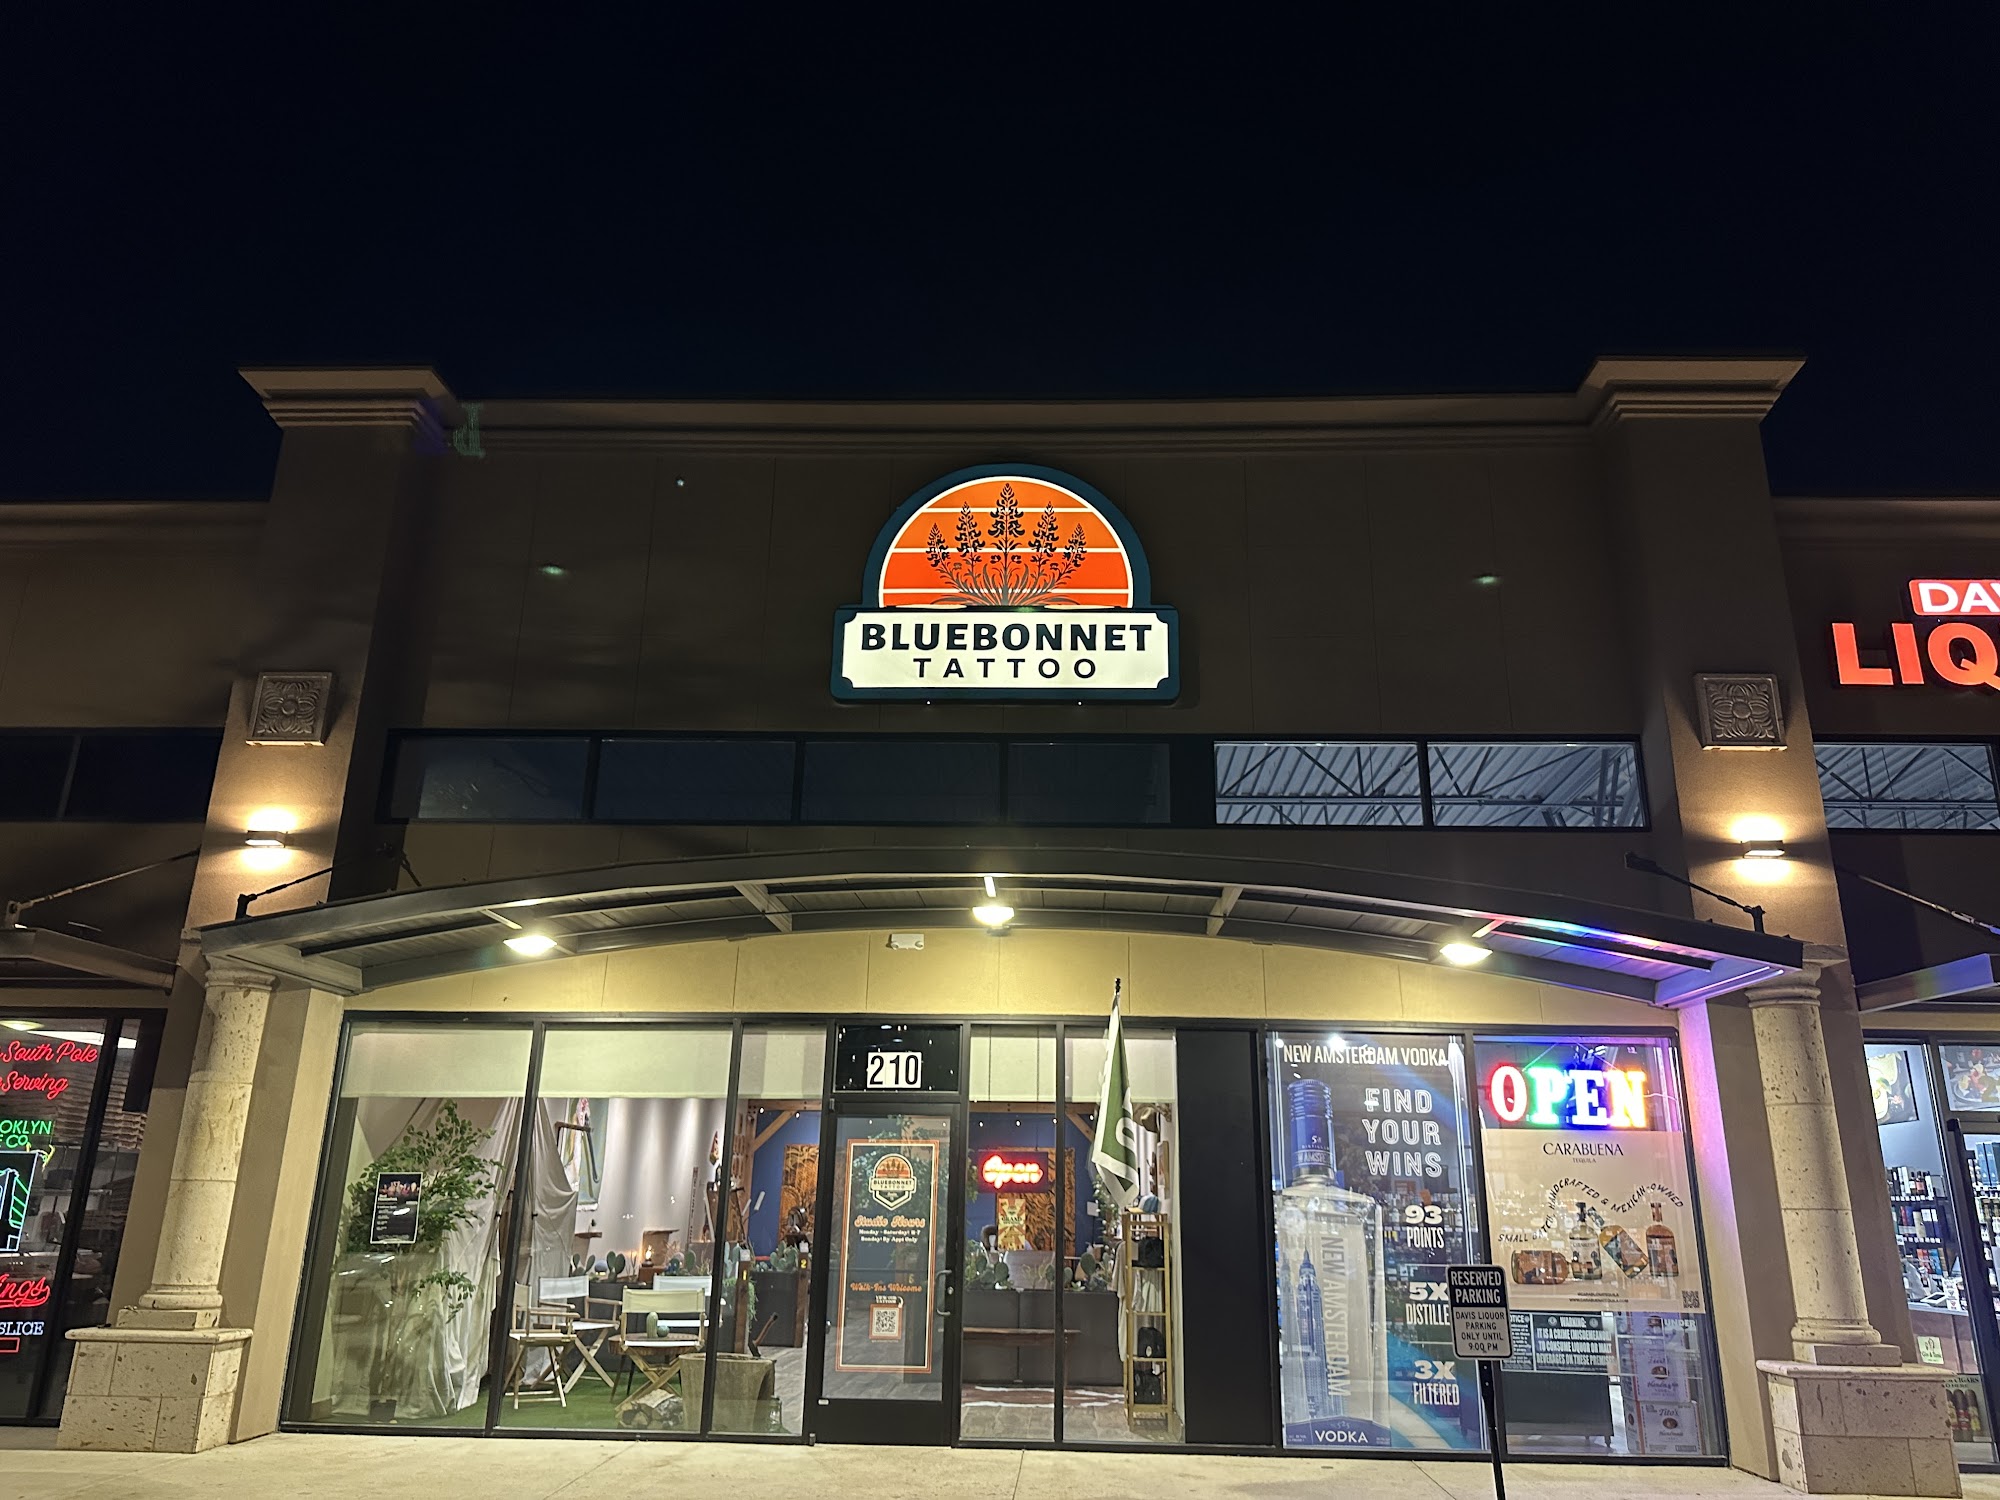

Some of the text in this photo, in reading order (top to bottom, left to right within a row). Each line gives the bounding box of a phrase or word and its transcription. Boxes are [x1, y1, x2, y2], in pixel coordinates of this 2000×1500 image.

[1918, 582, 2000, 613] DA
[861, 623, 1152, 652] BLUEBONNET
[1832, 622, 2000, 691] LIQ
[913, 658, 1096, 679] TATTOO
[3, 1040, 55, 1062] South
[56, 1041, 98, 1063] Pole
[1283, 1045, 1447, 1067] NEW AMSTERDAM VODKA
[869, 1054, 919, 1085] 210
[1, 1071, 68, 1100] Serving
[1365, 1087, 1433, 1114] FIND
[1491, 1065, 1647, 1128] OPEN
[1362, 1118, 1442, 1146] YOUR
[1543, 1142, 1624, 1156] CARABUENA
[983, 1155, 1043, 1189] Open
[1365, 1151, 1443, 1178] WINS
[1404, 1204, 1443, 1225] 93
[1498, 1233, 1529, 1243] SMALL
[1549, 1177, 1600, 1210] HANDCRAFTED
[1601, 1198, 1609, 1206] &
[1611, 1183, 1684, 1213] MEXICAN-OWNED
[854, 1214, 926, 1228] Studio Hours
[1406, 1226, 1445, 1248] POINTS
[801, 1258, 808, 1269] 2
[1321, 1236, 1346, 1277] NEW
[850, 1282, 923, 1292] Walk-Ins Welcome
[1450, 1270, 1502, 1287] RESERVED
[1409, 1282, 1449, 1301] 5X
[1455, 1288, 1501, 1304] PARKING
[1405, 1303, 1450, 1326] DISTILLE
[1455, 1311, 1505, 1320] DAVIS LIQUOR
[1559, 1316, 1587, 1328] WARNING:
[1664, 1319, 1696, 1327] UNDER
[0, 1321, 44, 1336] SLICE
[1465, 1321, 1497, 1330] PARKING
[1536, 1328, 1543, 1338] IT
[1544, 1328, 1549, 1339] IS
[1549, 1328, 1553, 1339] A
[1553, 1329, 1570, 1340] CRIME
[1323, 1278, 1351, 1396] AMSTERDAM
[1461, 1332, 1504, 1341] ONLY UNTIL
[1487, 1343, 1498, 1351] PM
[1547, 1341, 1572, 1352] CONSUME
[1414, 1360, 1456, 1380] 3X
[1573, 1355, 1589, 1365] THESE
[1413, 1382, 1460, 1406] FILTERED
[1315, 1430, 1369, 1443] VODKA
